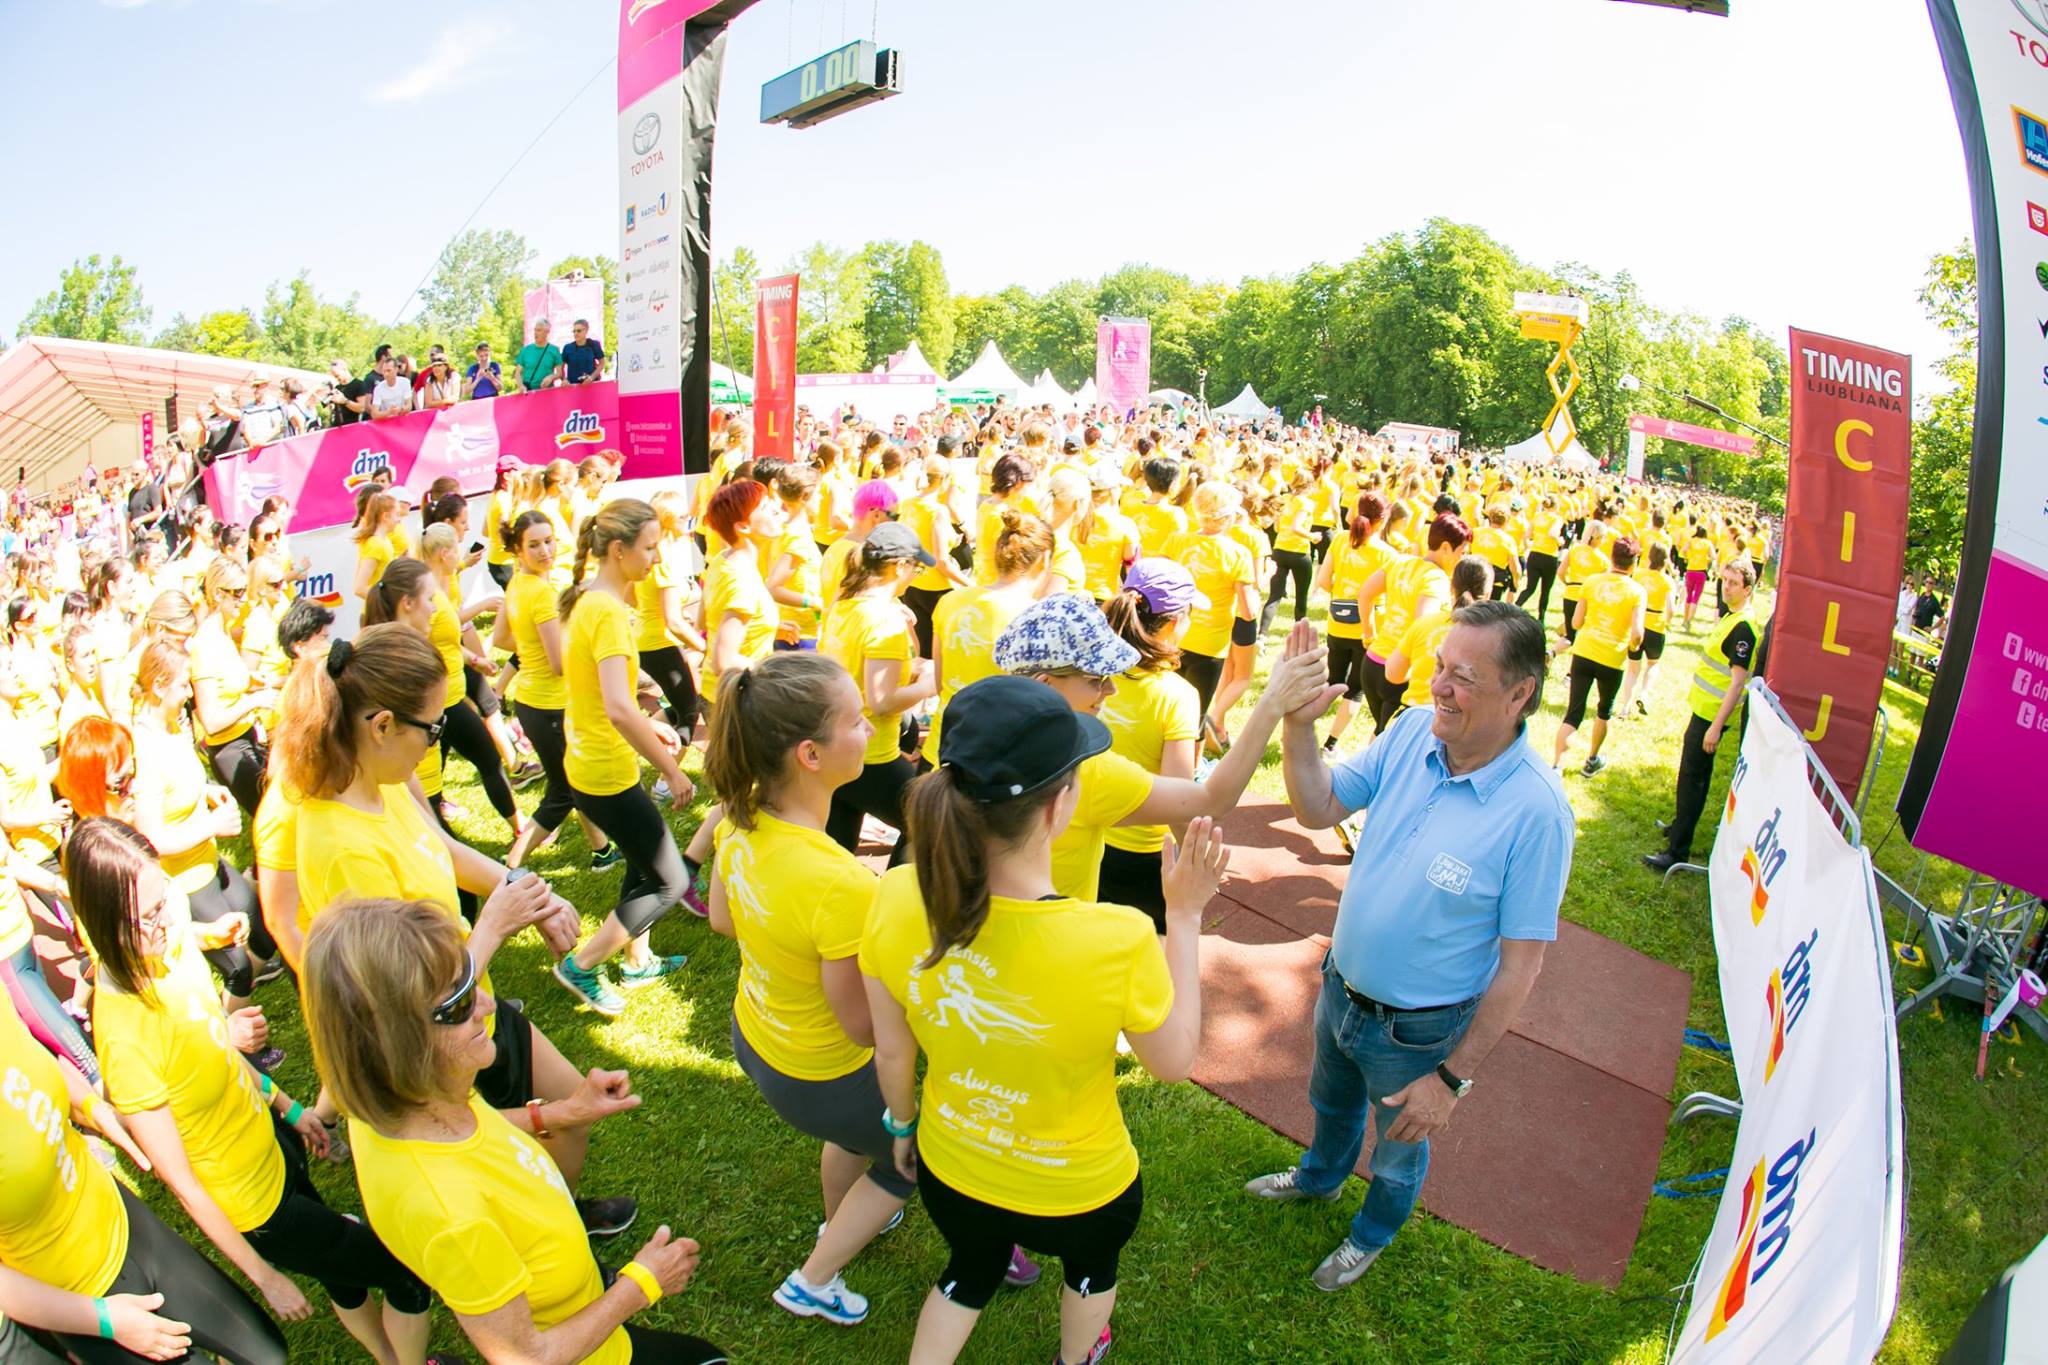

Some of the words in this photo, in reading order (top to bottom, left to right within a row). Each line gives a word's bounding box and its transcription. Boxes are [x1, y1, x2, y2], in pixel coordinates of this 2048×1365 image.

[630, 150, 664, 177] TOYOTA
[758, 284, 793, 302] TIMING
[1802, 348, 1903, 397] TIMING
[1808, 380, 1902, 414] LJUBLJANA
[565, 411, 598, 434] dm
[353, 450, 387, 476] dm
[1755, 807, 1787, 887] dm
[1782, 928, 1818, 1035] dm
[949, 1068, 1030, 1105] always
[1751, 1126, 1816, 1285] dm
